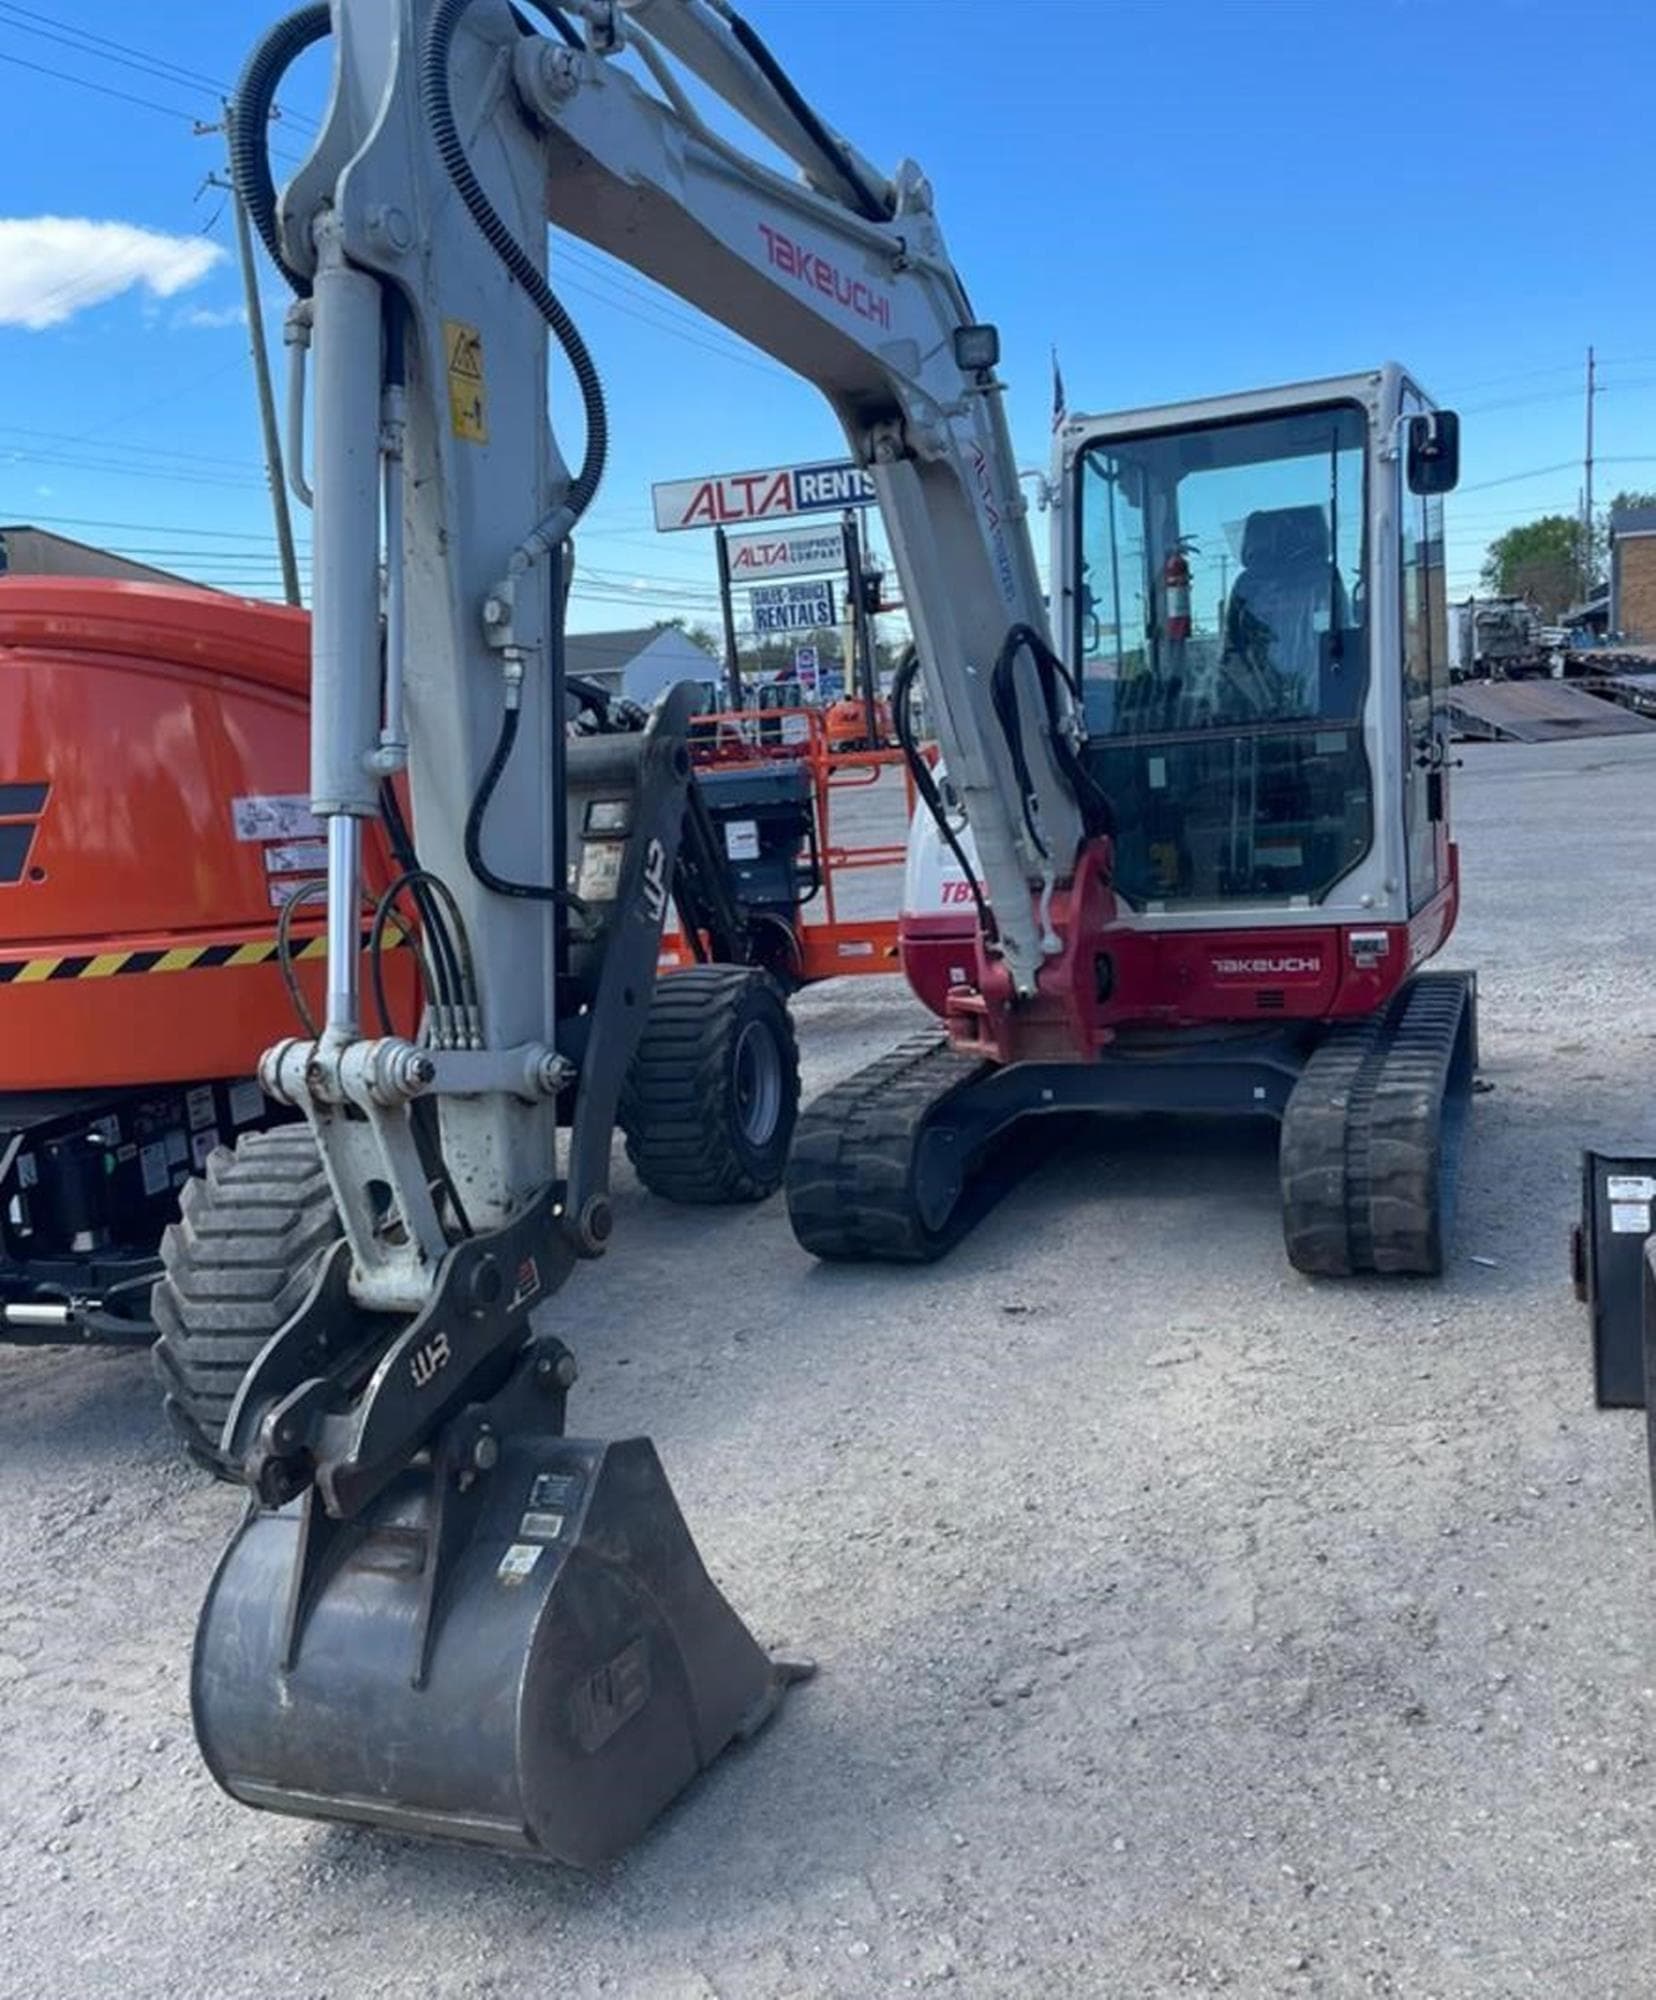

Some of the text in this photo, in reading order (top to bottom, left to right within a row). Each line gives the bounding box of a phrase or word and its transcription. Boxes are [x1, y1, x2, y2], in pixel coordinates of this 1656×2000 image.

[681, 469, 876, 525] ALTA RENTS
[733, 542, 787, 568] ALTA
[756, 601, 829, 630] RENTALS
